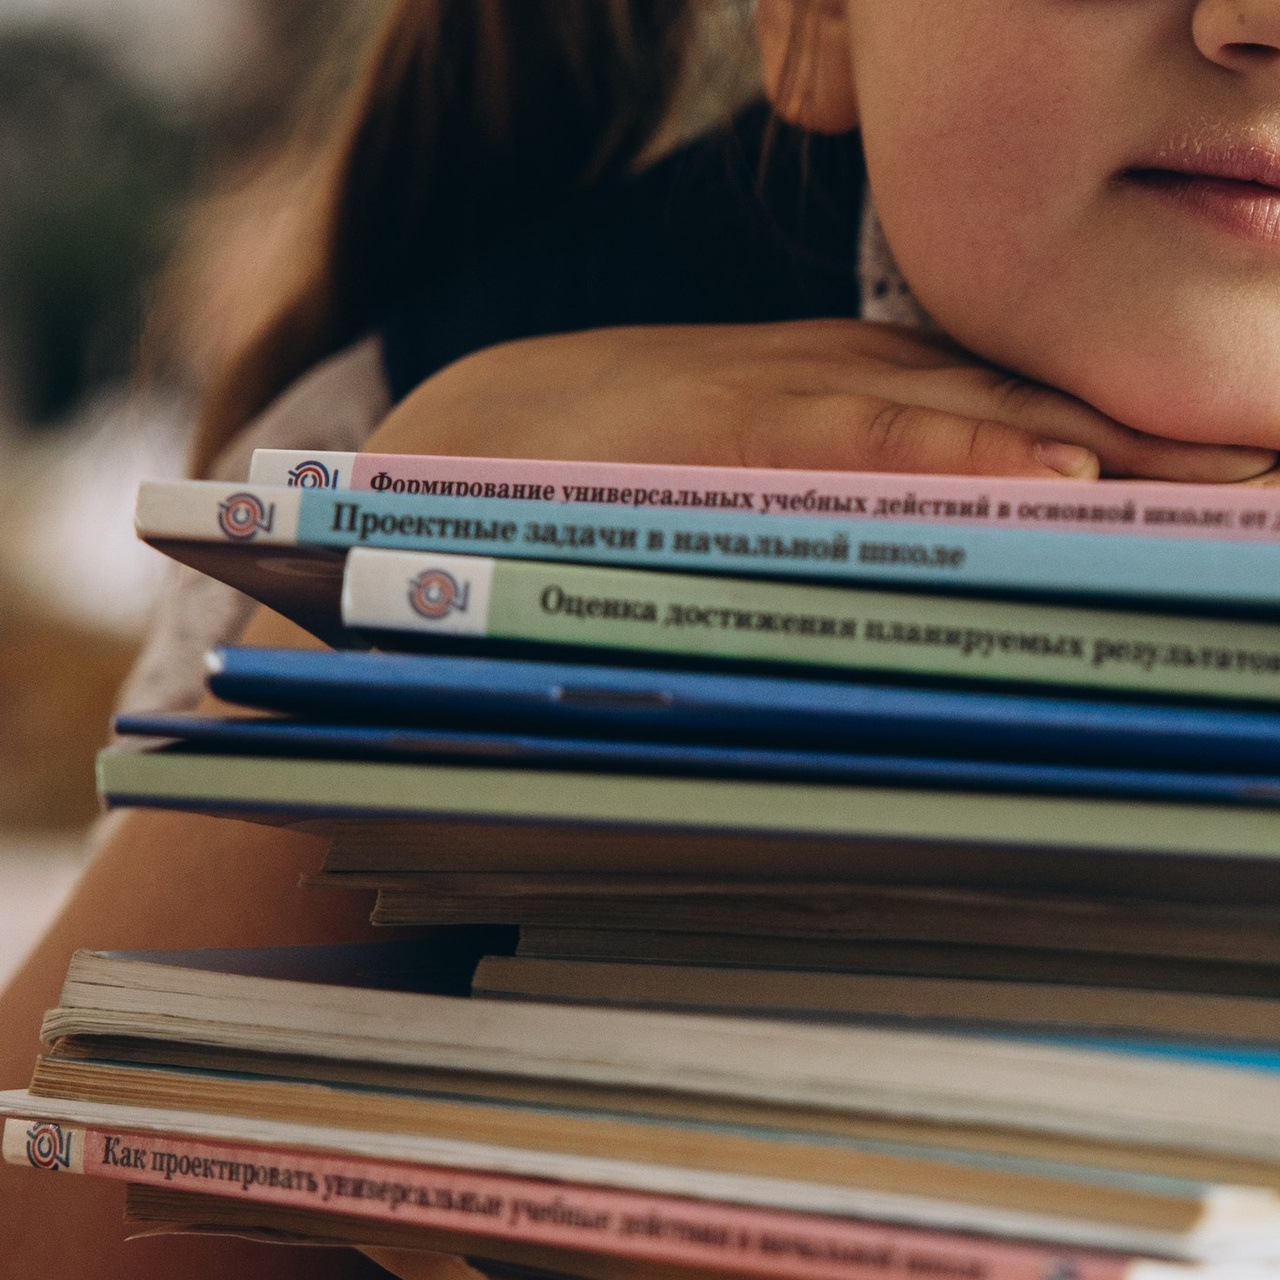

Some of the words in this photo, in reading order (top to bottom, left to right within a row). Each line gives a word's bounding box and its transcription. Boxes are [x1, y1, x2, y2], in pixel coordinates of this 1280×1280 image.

[371, 471, 554, 500] Формирование
[562, 485, 753, 510] универсальных
[759, 488, 866, 515] учебных
[872, 491, 991, 521] действий
[997, 501, 1011, 520] в
[1017, 498, 1136, 524] основной
[331, 502, 518, 544] Проектные
[523, 519, 637, 551] задачи
[646, 529, 664, 551] в
[672, 527, 851, 562] начальной
[858, 539, 966, 570] школе
[540, 584, 657, 627] Оценка
[661, 600, 857, 641] достижения
[864, 620, 1083, 662] планируемых
[102, 1135, 146, 1170] Как
[151, 1151, 319, 1194] проектировать
